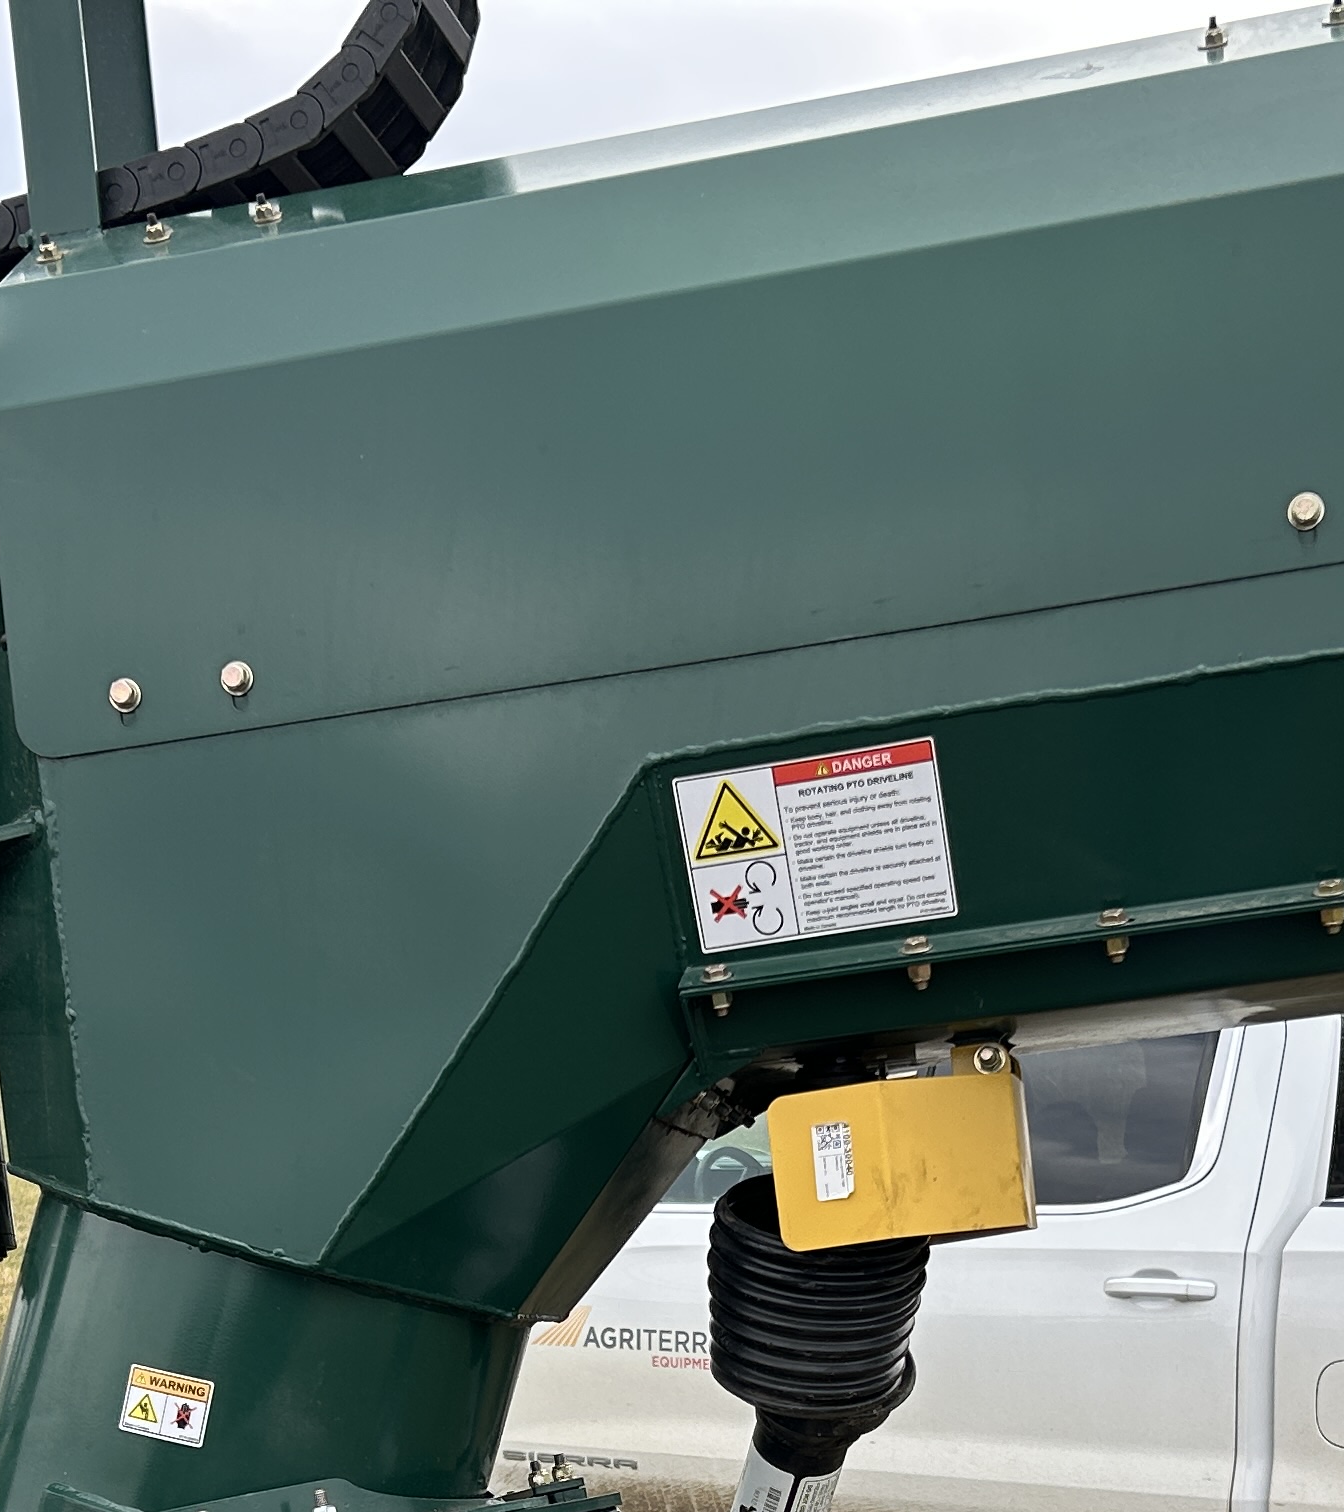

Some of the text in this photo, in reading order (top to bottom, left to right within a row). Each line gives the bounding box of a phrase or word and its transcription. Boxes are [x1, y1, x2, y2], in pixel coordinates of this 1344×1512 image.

[831, 751, 892, 773] DANGER
[798, 771, 913, 798] ROTATING PTO DRIVELINE
[848, 794, 867, 804] injury
[583, 1326, 708, 1354] AGRITERR
[651, 1355, 710, 1371] EQUIPME
[149, 1376, 205, 1397] WARNING
[502, 1450, 638, 1470] SIERRA
